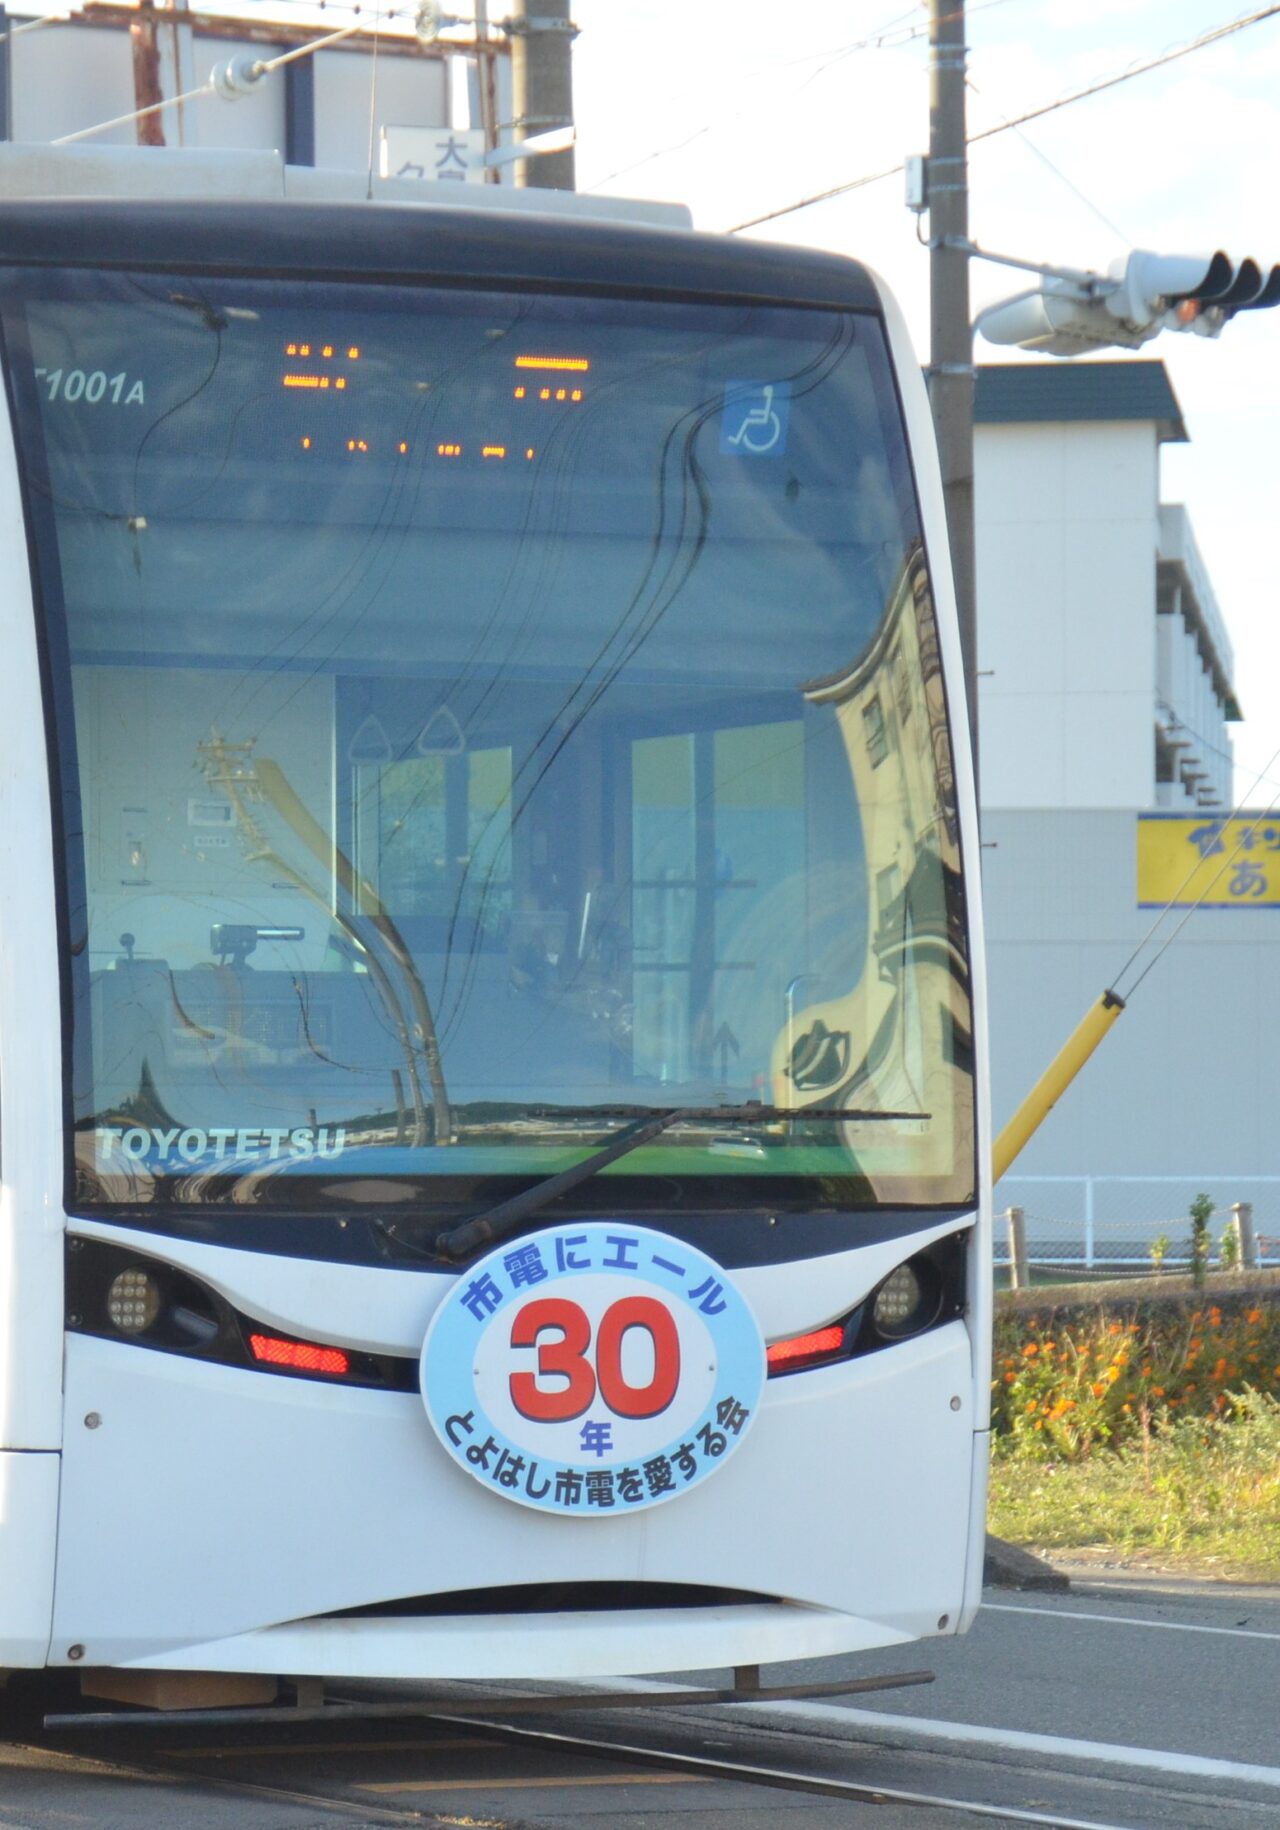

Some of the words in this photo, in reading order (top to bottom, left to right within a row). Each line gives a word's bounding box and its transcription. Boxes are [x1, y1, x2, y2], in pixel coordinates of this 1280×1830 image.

[95, 1128, 346, 1160] TOYOTETSU
[459, 1234, 728, 1322] 市電にエール
[509, 1296, 681, 1424] 30
[444, 1395, 751, 1508] とよはし市電を愛する会
[579, 1420, 613, 1457] 年
